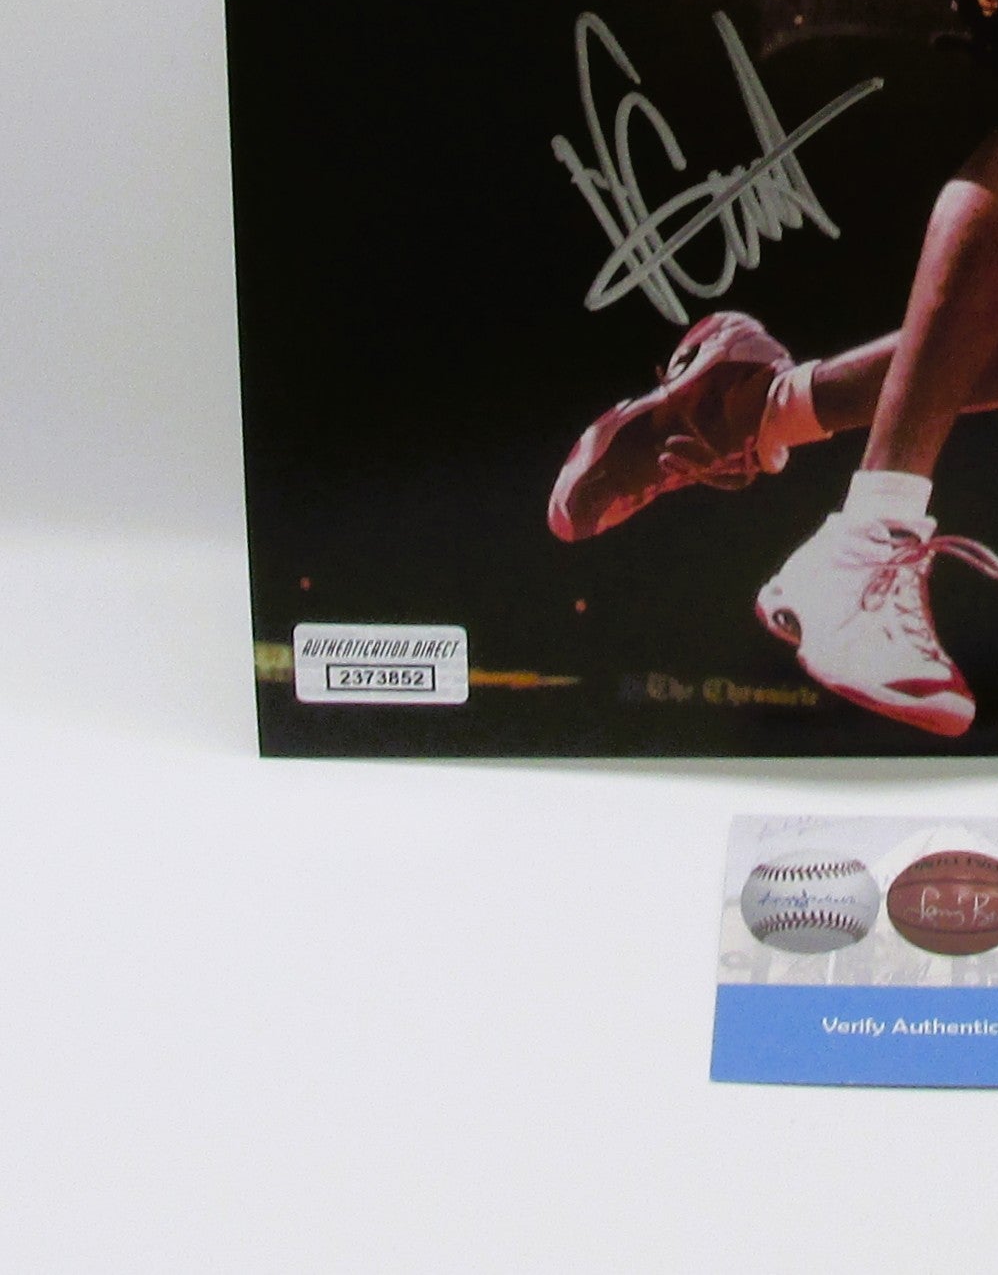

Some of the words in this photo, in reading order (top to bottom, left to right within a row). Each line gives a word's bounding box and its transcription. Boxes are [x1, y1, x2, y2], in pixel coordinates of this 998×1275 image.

[302, 638, 410, 658] AUTHENTICATION
[412, 639, 460, 659] DIRECT
[340, 669, 425, 686] 2373852
[822, 1017, 886, 1037] Verify
